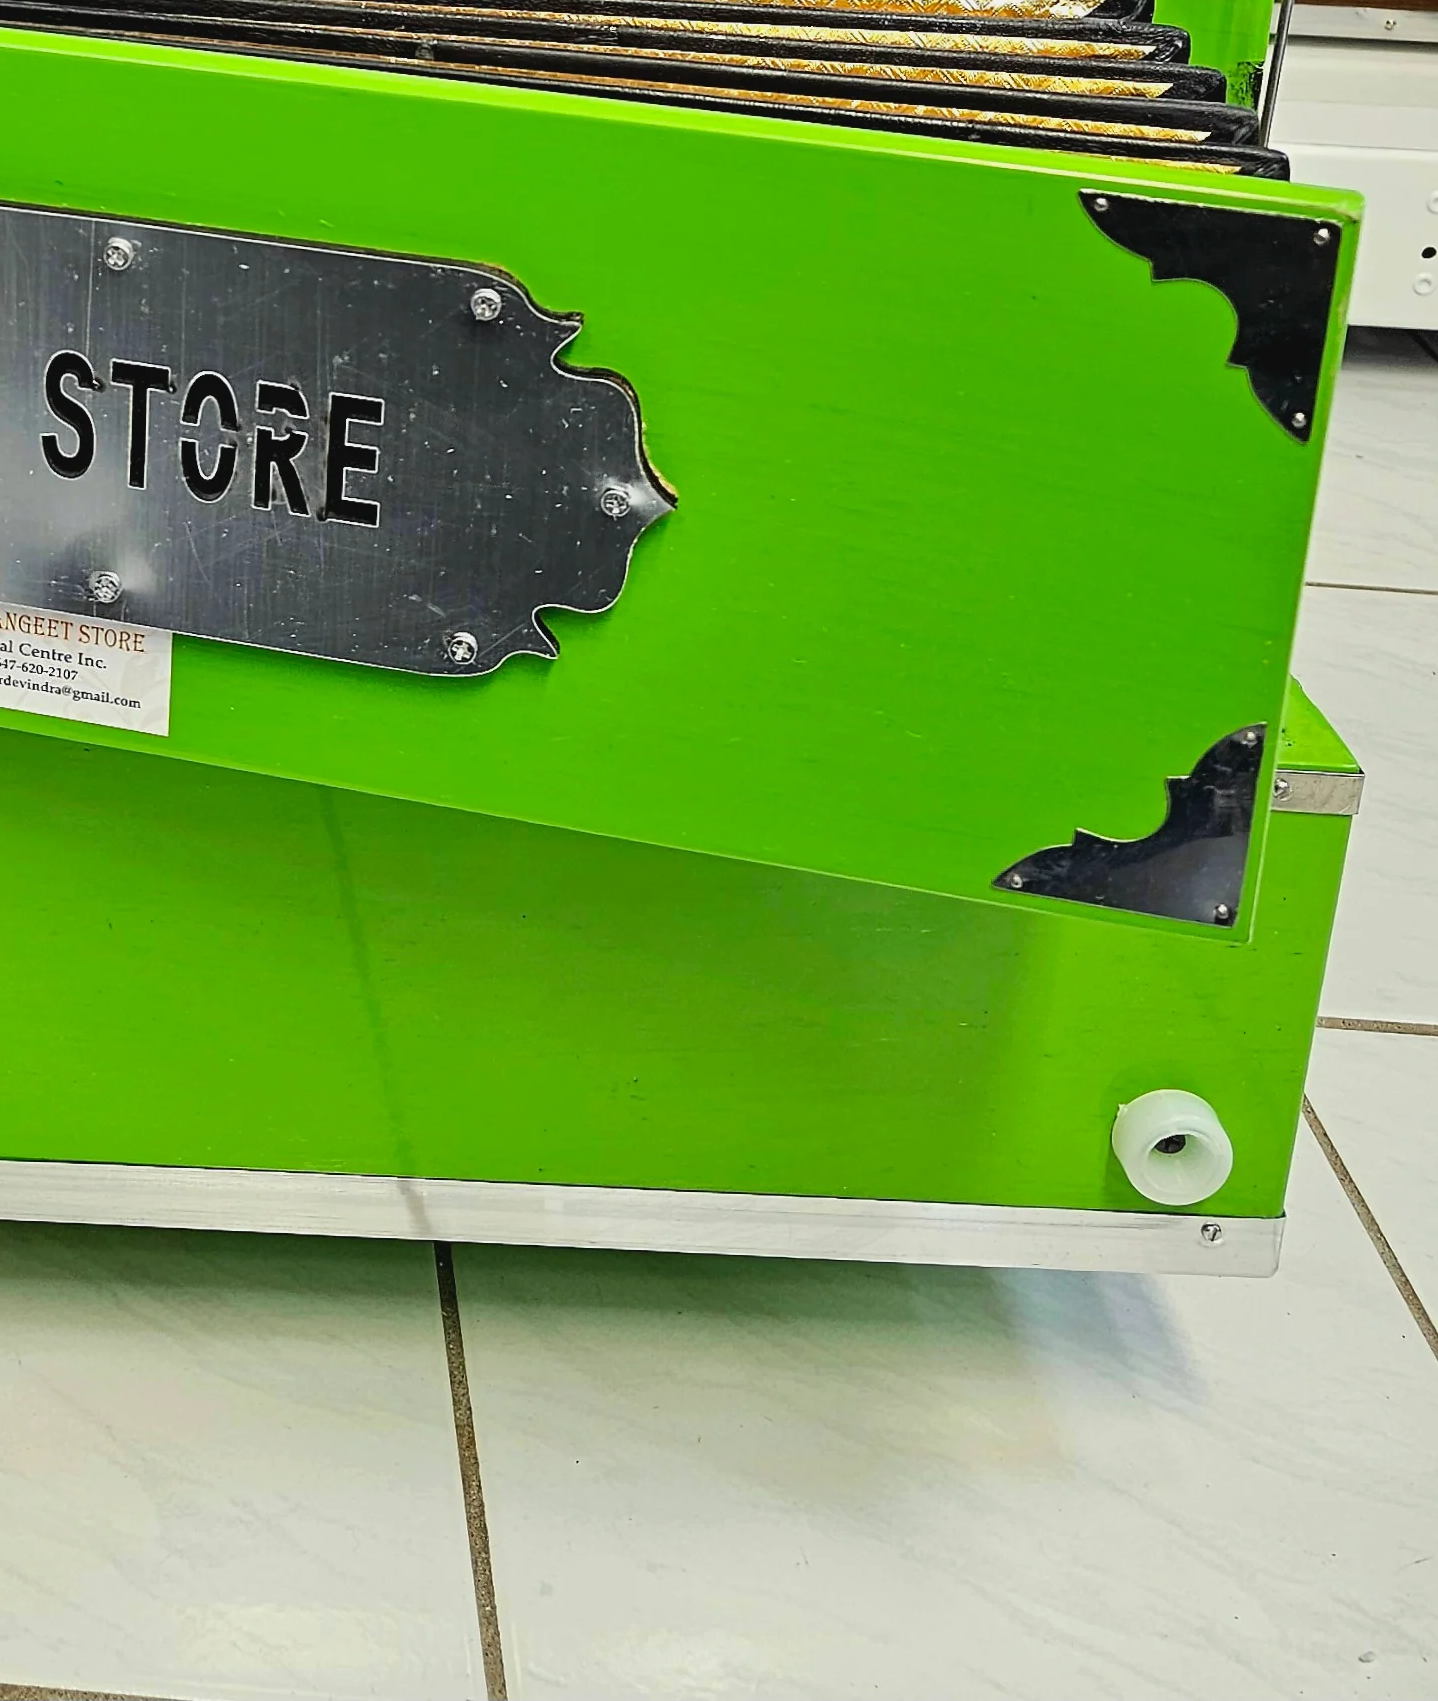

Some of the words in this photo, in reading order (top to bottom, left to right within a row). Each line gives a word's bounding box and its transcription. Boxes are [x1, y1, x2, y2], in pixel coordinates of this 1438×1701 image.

[41, 349, 386, 528] STORE
[77, 624, 146, 653] STORE
[18, 642, 74, 664] Centre
[77, 651, 109, 670] Inc.
